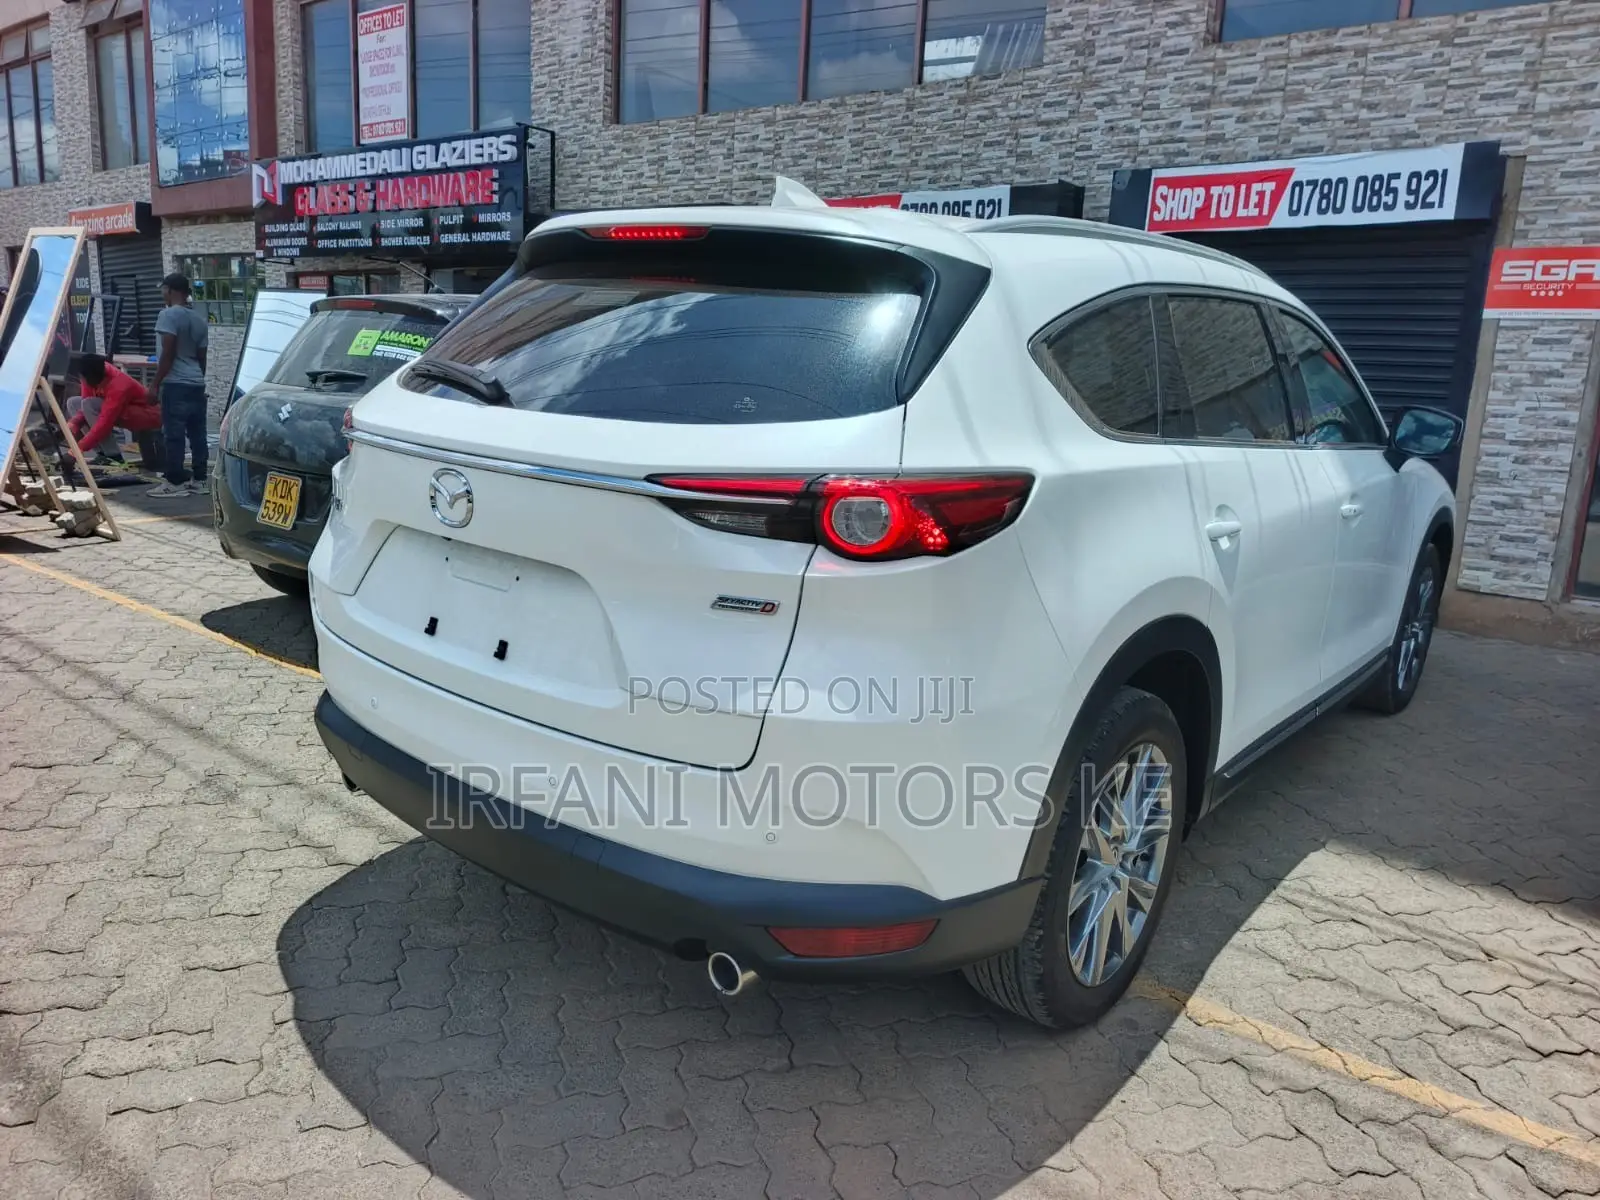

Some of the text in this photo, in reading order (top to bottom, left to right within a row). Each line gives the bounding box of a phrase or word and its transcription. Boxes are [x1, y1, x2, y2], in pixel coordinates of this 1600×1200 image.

[360, 9, 404, 34] OFFICES TO LET
[280, 134, 518, 184] MOHAMMEDALI GLAZIERS
[295, 168, 499, 216] GLASS & HARDWARE
[1153, 168, 1448, 221] SHOP TO LET 0780 085 921
[105, 207, 132, 229] arcade
[380, 218, 424, 229] SIDE MIRROR
[440, 214, 464, 224] PULPIT
[478, 212, 511, 223] MIRRORS
[265, 222, 306, 232] BUILDING GLASS
[317, 222, 338, 232] BALCONY
[317, 238, 372, 248] OFFICE PARTITIONS
[381, 235, 430, 246] SHOWER CUBICLES
[440, 231, 511, 243] GENERAL HARDWARE
[1500, 259, 1600, 282] SGA
[1522, 282, 1574, 290] SECURITY
[379, 330, 431, 348] AMARON
[272, 478, 296, 501] KDK
[261, 500, 292, 525] 539W
